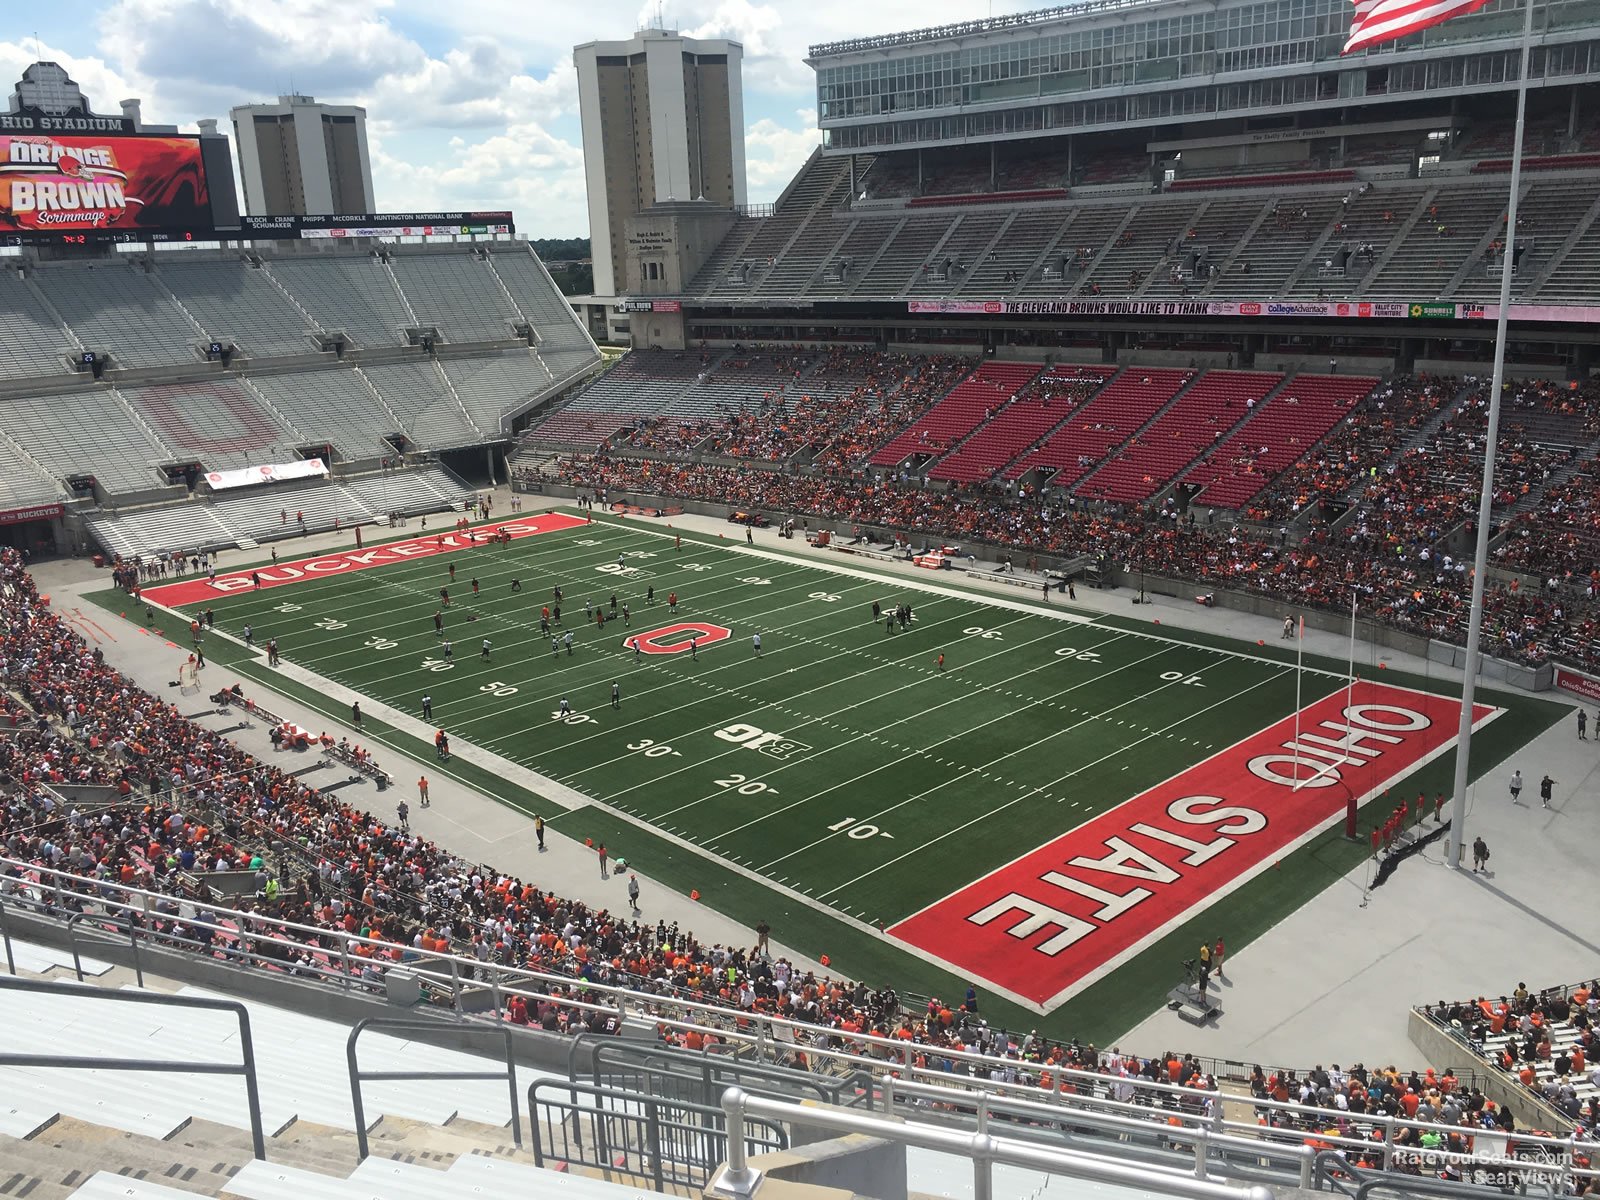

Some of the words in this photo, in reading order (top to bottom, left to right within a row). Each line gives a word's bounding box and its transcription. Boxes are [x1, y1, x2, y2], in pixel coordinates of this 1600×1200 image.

[42, 118, 123, 131] STADIUM
[10, 143, 115, 168] ORANGE
[11, 181, 127, 211] BROWN
[37, 211, 106, 227] Scrimmage
[1005, 302, 1020, 313] THE
[1022, 302, 1067, 314] CLEVELAND
[1069, 302, 1106, 314] BROWNS
[1108, 302, 1138, 314] WOULD
[1140, 302, 1160, 314] LIKE
[1163, 303, 1175, 314] TO
[1177, 303, 1208, 314] THANK
[1268, 304, 1328, 314] CollegeAdvantage
[212, 344, 220, 352] 25
[84, 354, 93, 362] 25
[17, 507, 60, 520] BUCKEYES
[209, 523, 539, 592] BUCKEYES
[807, 592, 842, 602] 50
[274, 604, 302, 614] 10
[314, 620, 348, 631] 20
[962, 626, 1001, 640] 30
[364, 639, 398, 650] 30
[1054, 647, 1099, 662] 20
[420, 660, 455, 672] 40
[1159, 671, 1201, 686] 10
[480, 681, 518, 697] 50
[626, 740, 673, 758] 30
[1245, 703, 1433, 789] OHIO
[713, 774, 771, 796] 20
[827, 817, 881, 840] 10
[966, 793, 1268, 957] STATE
